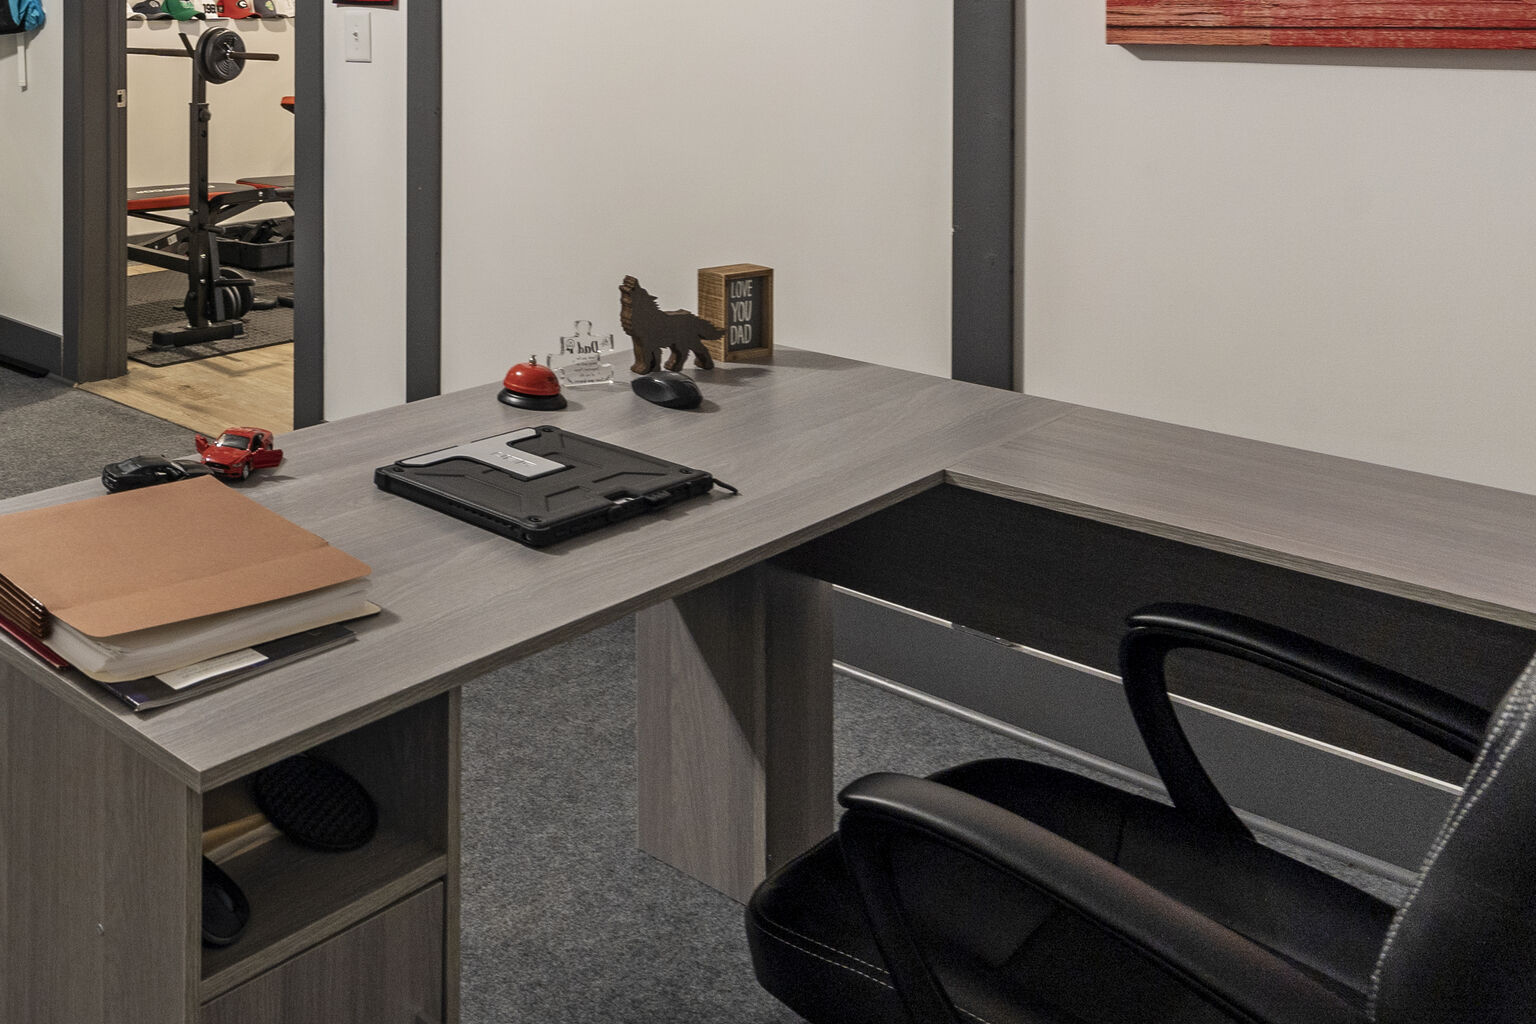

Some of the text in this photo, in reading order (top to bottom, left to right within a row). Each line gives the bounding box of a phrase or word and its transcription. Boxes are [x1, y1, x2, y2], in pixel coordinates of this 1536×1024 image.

[730, 279, 752, 299] LOVE
[730, 300, 752, 322] YOU
[729, 324, 752, 346] DAD
